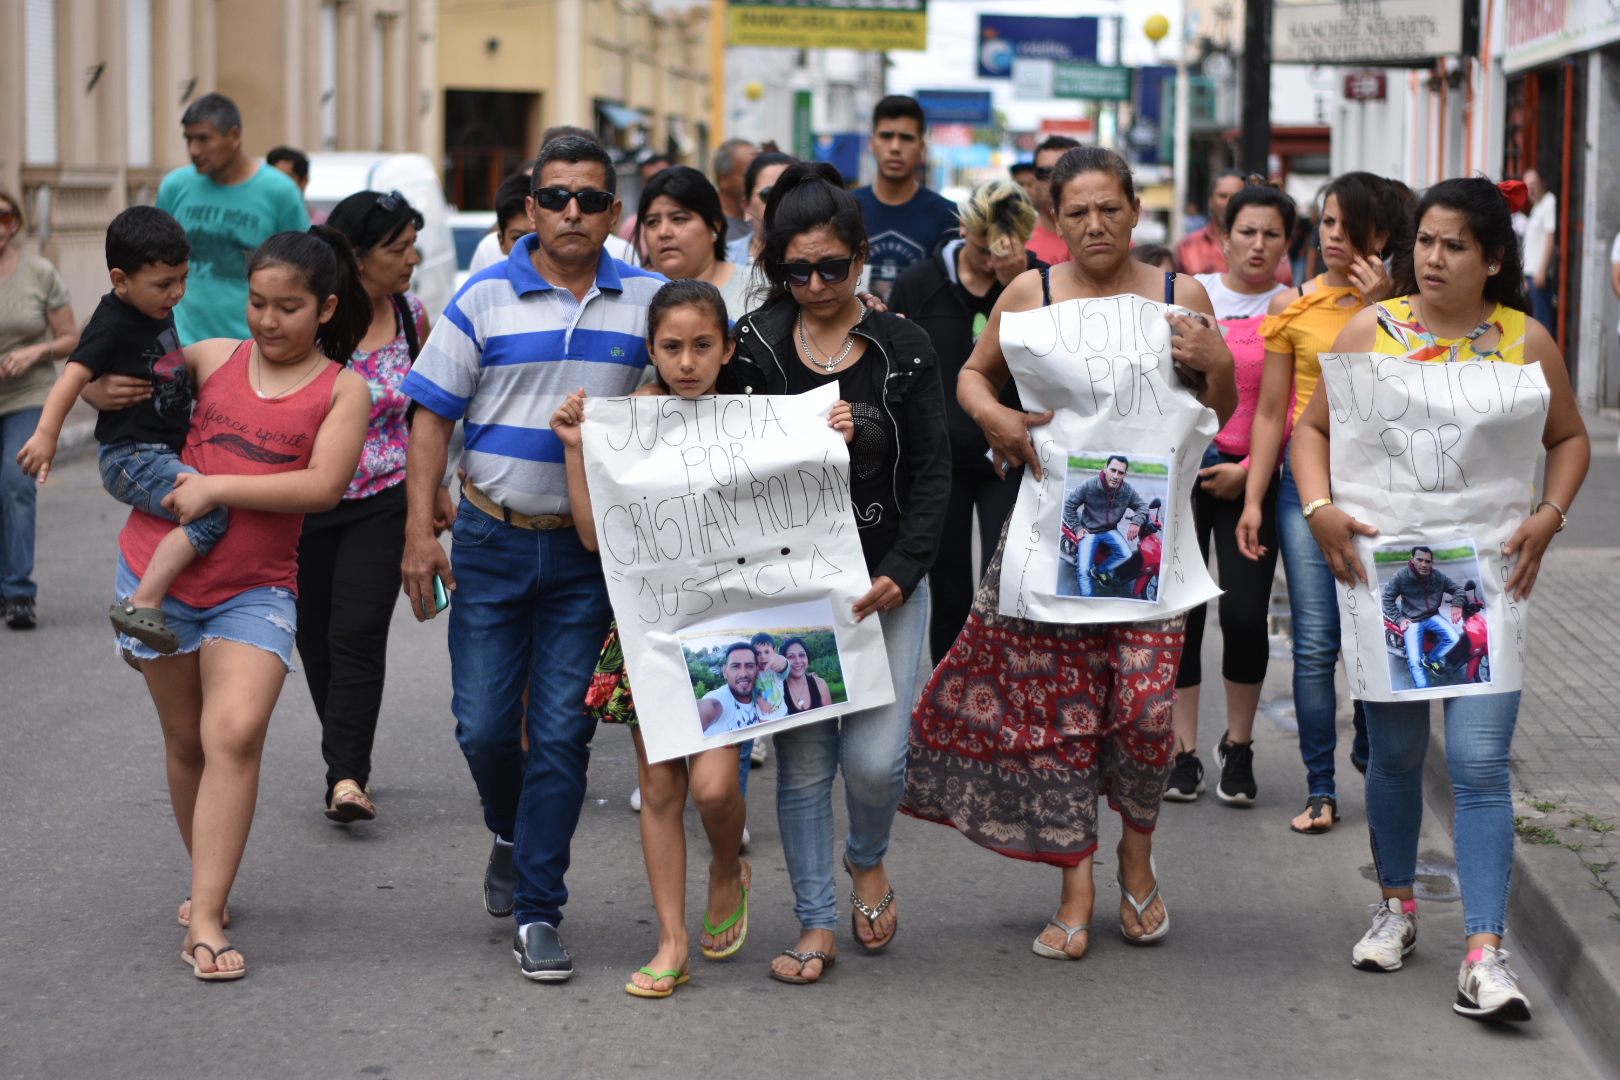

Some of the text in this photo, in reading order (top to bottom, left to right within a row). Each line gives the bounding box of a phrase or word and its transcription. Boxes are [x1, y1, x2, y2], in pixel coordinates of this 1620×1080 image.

[1085, 352, 1163, 417] POR
[201, 402, 310, 449] fierce spirit
[681, 442, 758, 494] POR
[1378, 423, 1469, 493] POR
